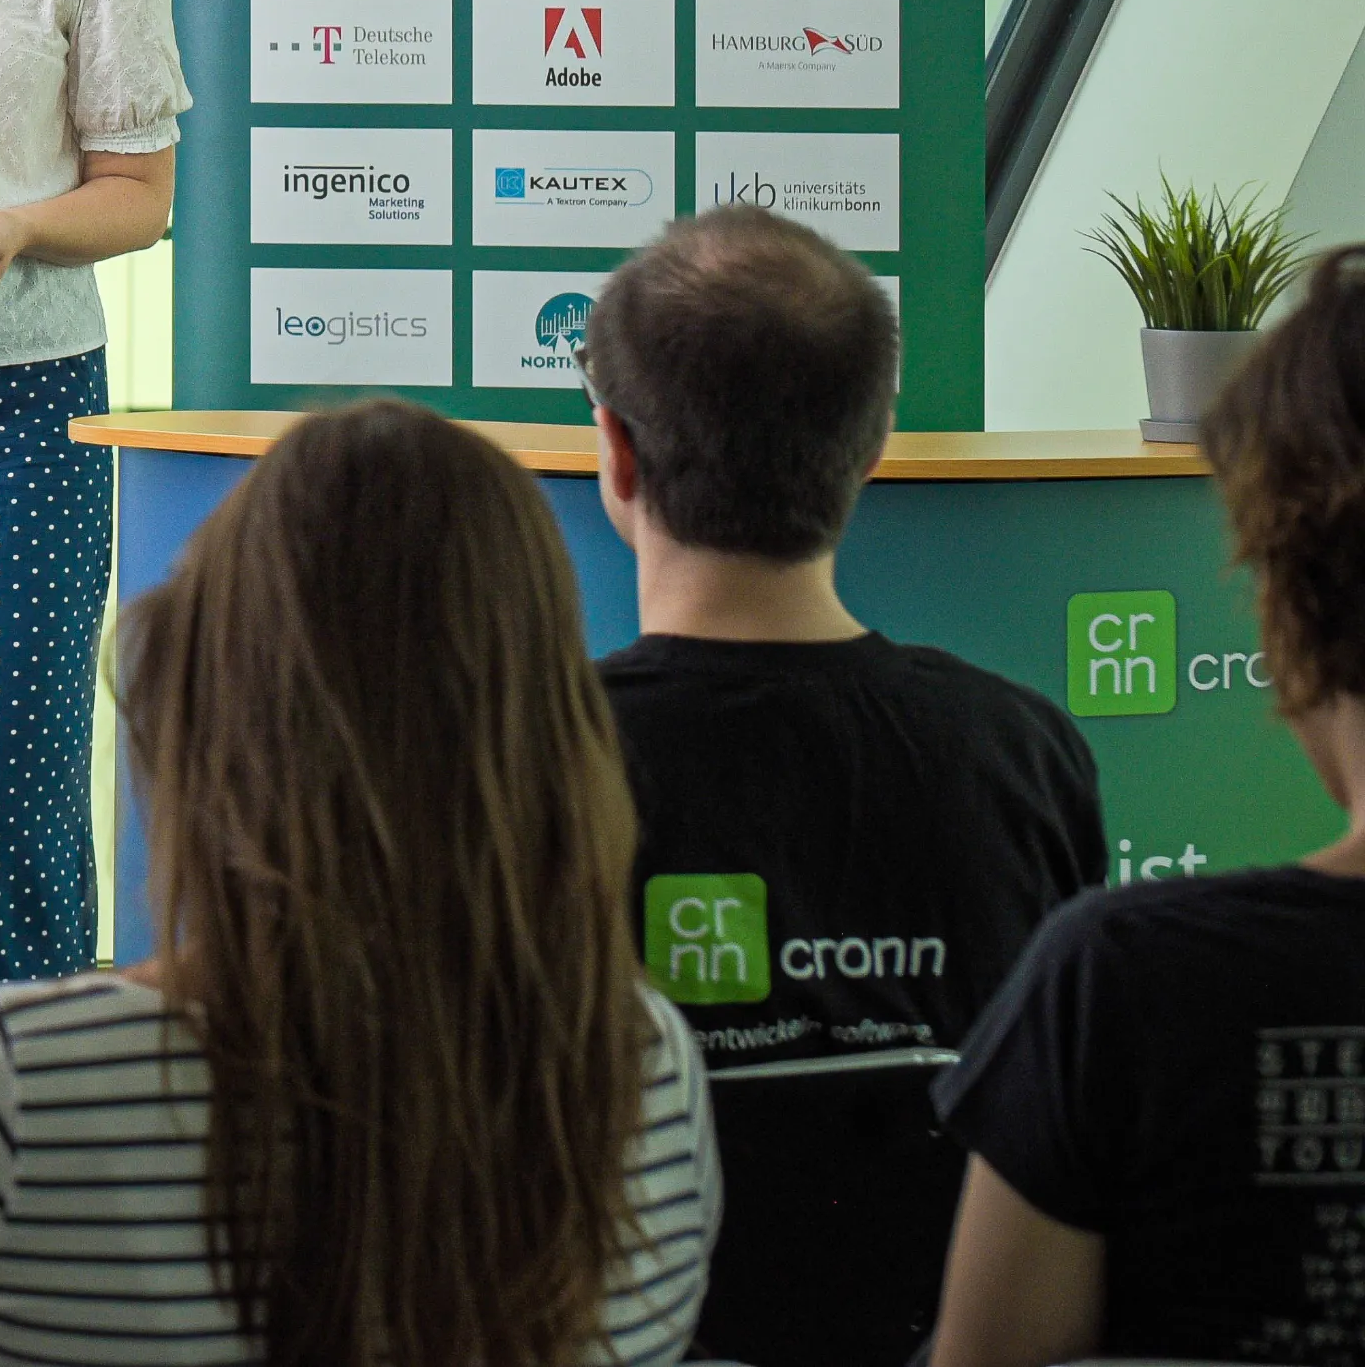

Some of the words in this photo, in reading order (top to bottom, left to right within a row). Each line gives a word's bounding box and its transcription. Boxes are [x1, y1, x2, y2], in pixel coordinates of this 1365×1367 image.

[354, 27, 432, 42] Deutsche
[713, 34, 805, 50] HAMBURG
[844, 34, 883, 53] SÜD
[353, 49, 425, 65] Telekom
[767, 62, 795, 70] Maersk
[798, 62, 836, 71] Company
[546, 67, 601, 86] Adobe
[285, 165, 409, 199] ingenico
[530, 177, 626, 190] KAUTEX
[784, 182, 865, 194] universitäts
[369, 198, 424, 209] Marketing
[589, 198, 627, 207] Company
[784, 198, 880, 211] klinikumbonn
[369, 210, 420, 220] Solutions
[276, 307, 426, 345] leogistics
[1188, 652, 1273, 690] cro
[782, 938, 944, 978] cronn
